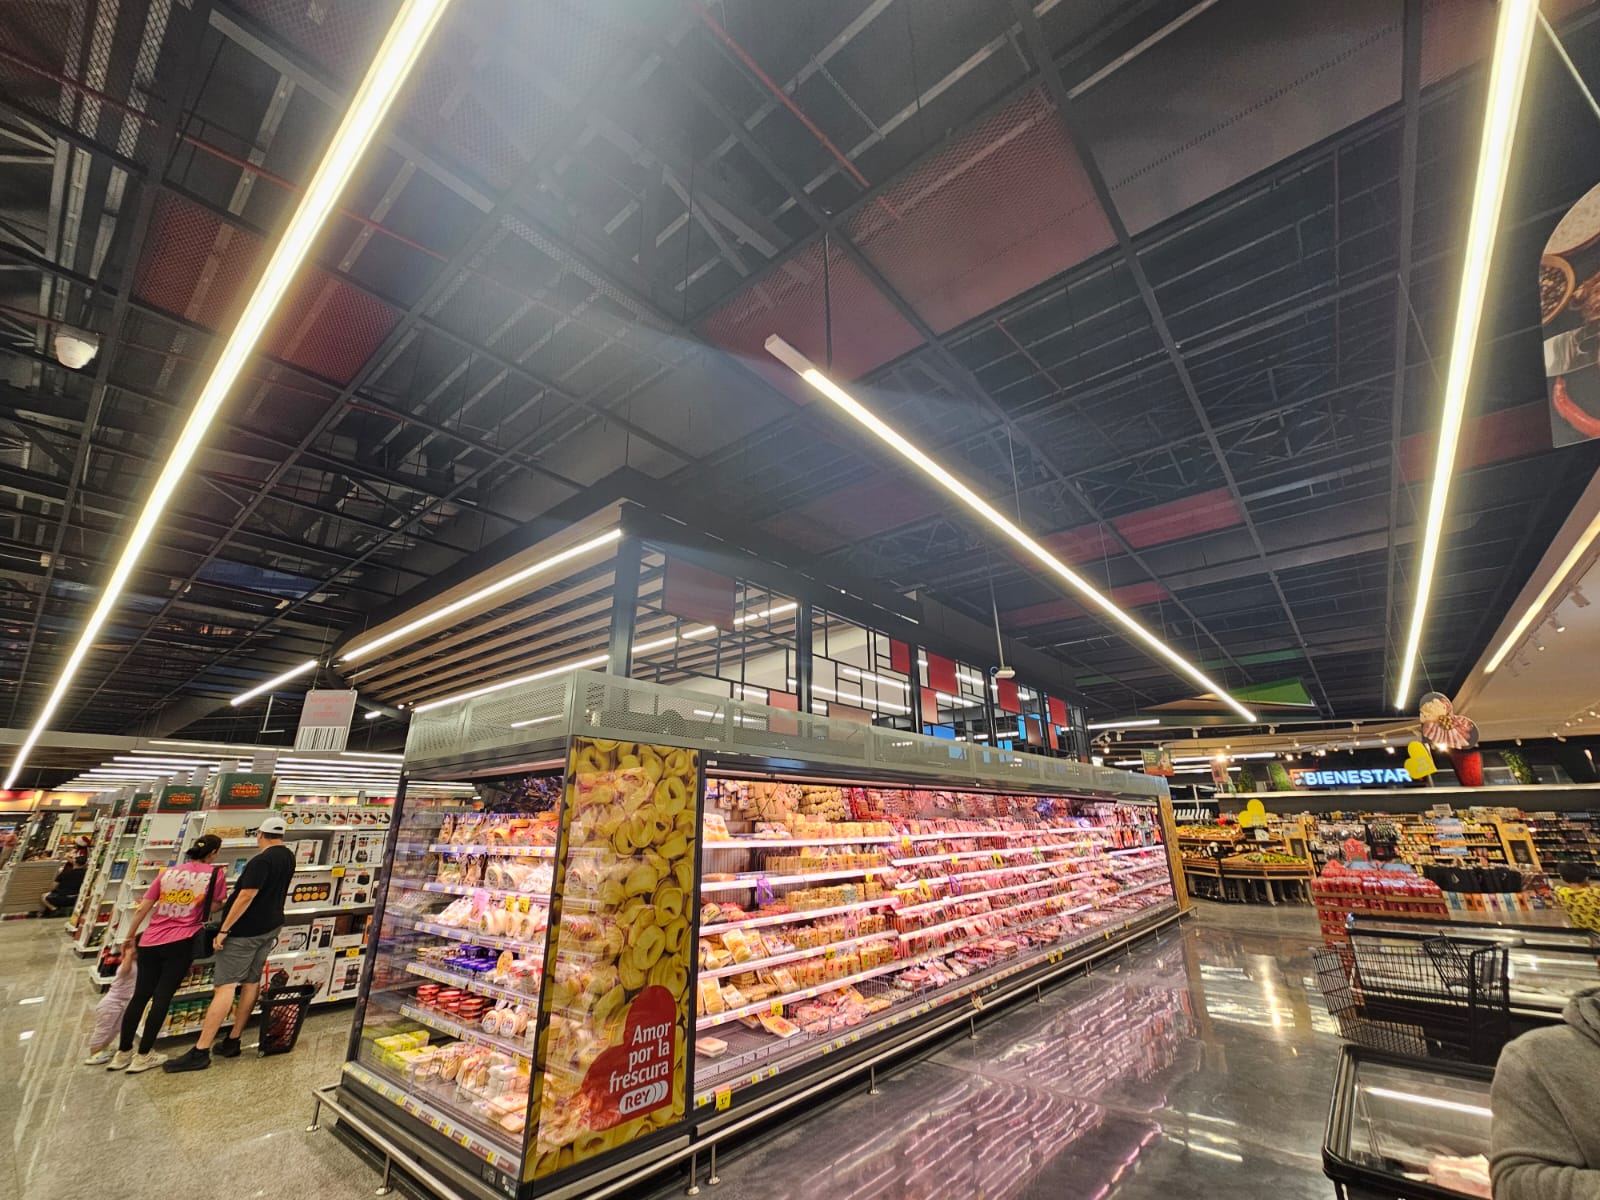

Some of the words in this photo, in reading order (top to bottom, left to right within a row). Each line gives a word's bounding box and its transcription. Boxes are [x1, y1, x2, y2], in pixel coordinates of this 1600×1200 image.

[1304, 767, 1412, 785] BIENESTAR
[632, 1021, 671, 1046] Amor
[629, 1046, 654, 1073] por
[658, 1038, 670, 1057] la
[609, 1060, 669, 1094] frescura
